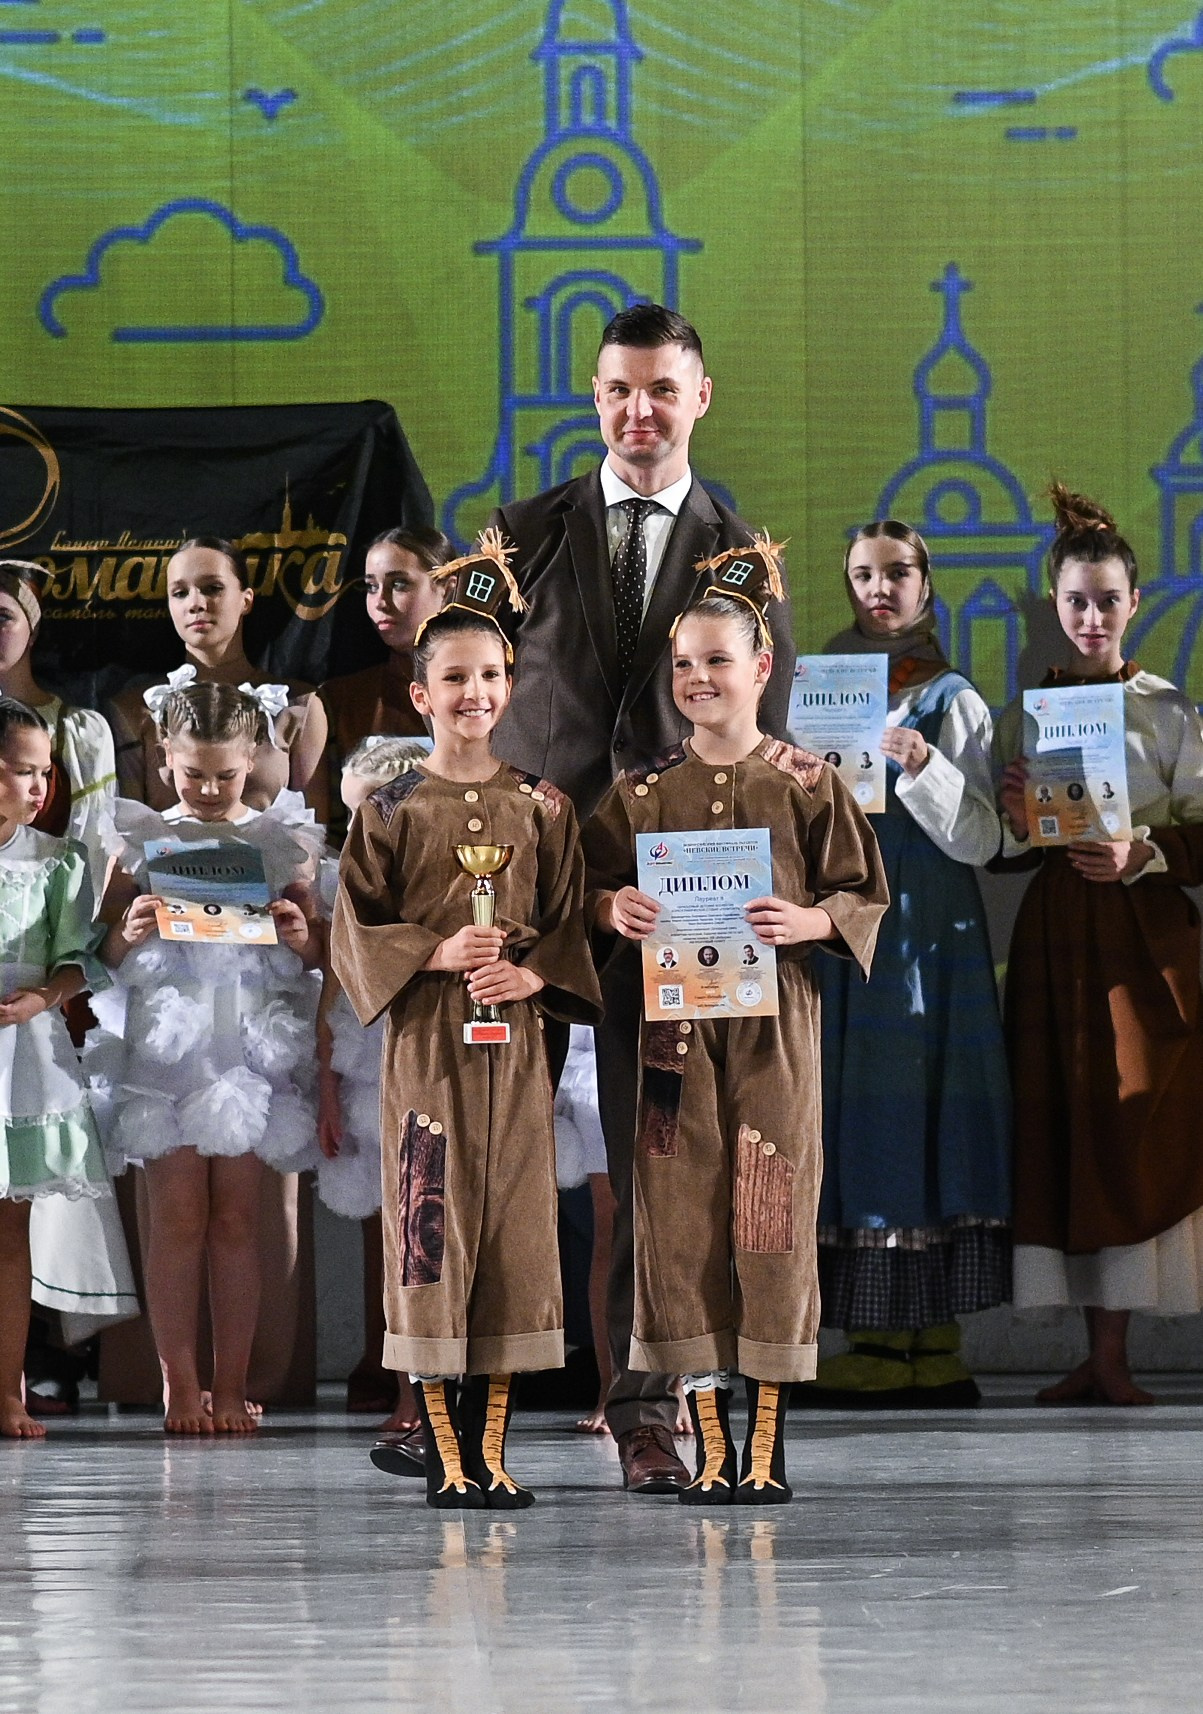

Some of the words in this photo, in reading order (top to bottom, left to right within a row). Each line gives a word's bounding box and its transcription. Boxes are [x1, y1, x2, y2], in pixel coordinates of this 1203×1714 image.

[50, 528, 188, 551] Санкт-Петерб
[796, 692, 870, 708] ДИПЛОМ
[1041, 722, 1107, 740] ДИПЛОМ
[658, 874, 750, 896] ДИПЛОМ
